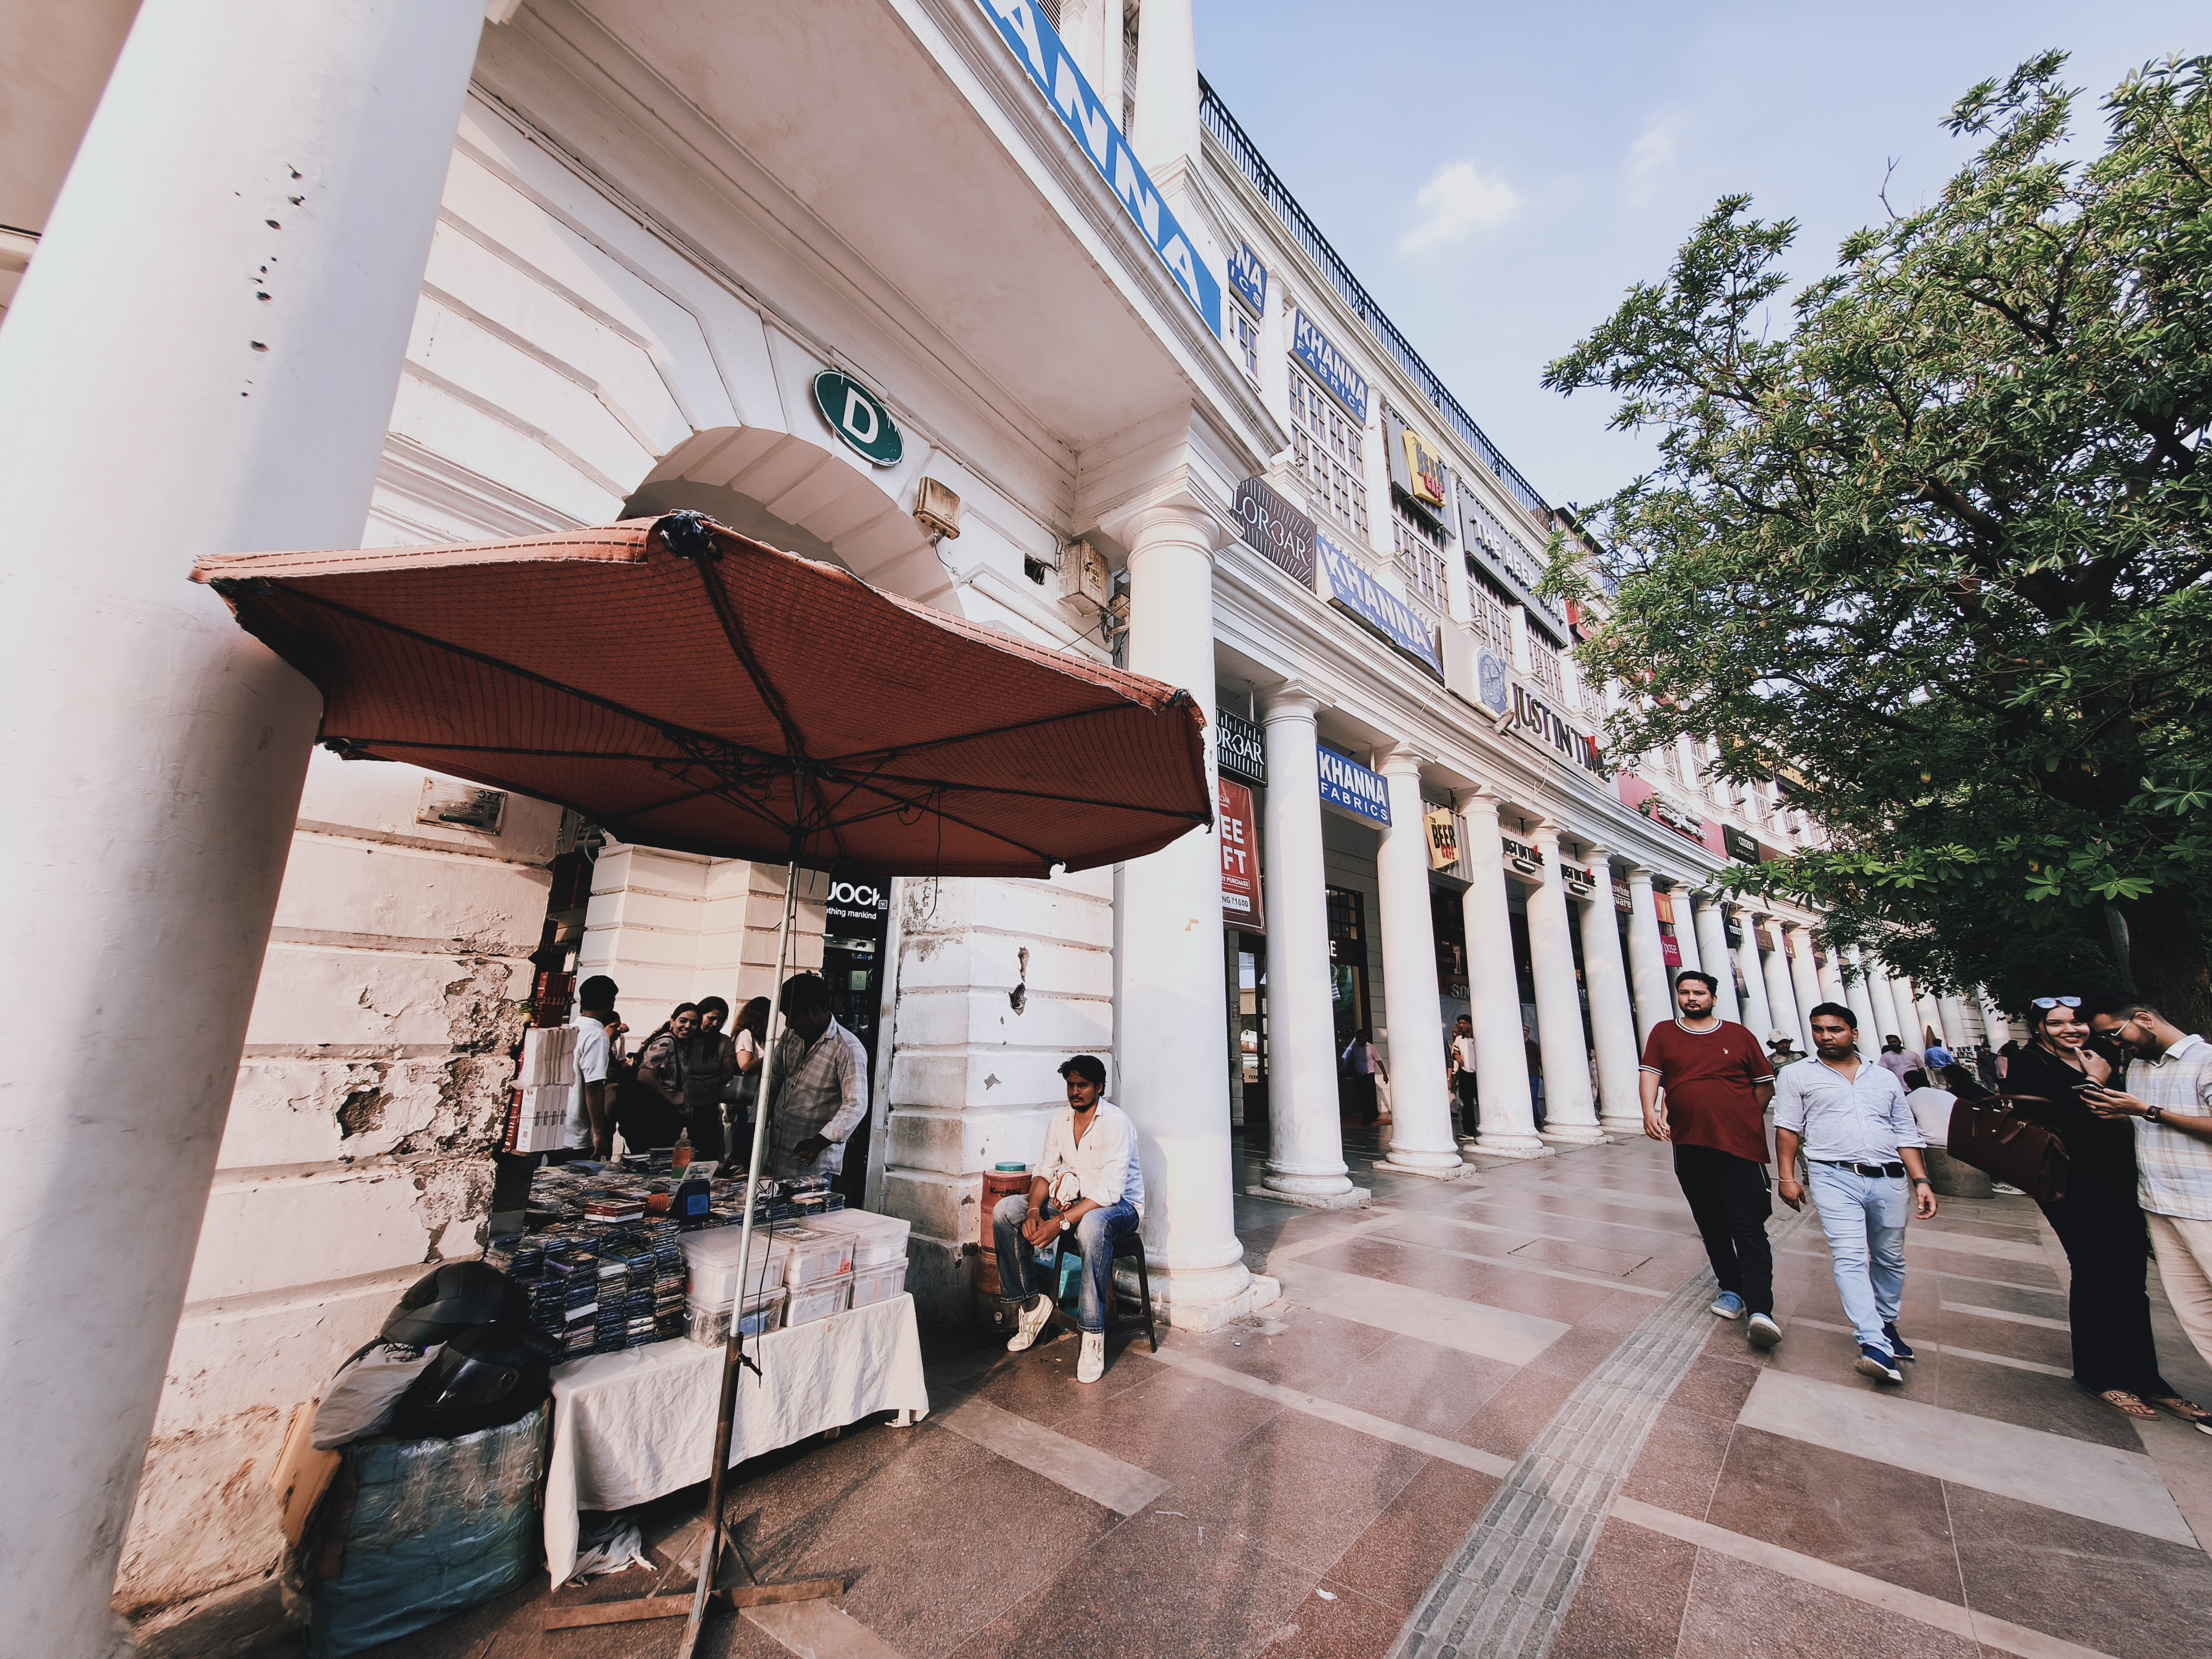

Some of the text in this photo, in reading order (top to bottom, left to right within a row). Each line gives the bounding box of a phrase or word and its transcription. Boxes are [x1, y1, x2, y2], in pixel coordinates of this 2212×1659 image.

[1230, 242, 1263, 297] NA
[1296, 338, 1366, 420] FABRICS
[1297, 313, 1367, 404] KHANNA
[842, 386, 879, 445] D
[1469, 514, 1502, 560] THE
[1321, 542, 1431, 653] KHANNA
[1319, 750, 1387, 807] KHANNA
[1320, 781, 1388, 821] FABRICS
[1431, 824, 1457, 849] BEER
[1226, 876, 1249, 887] PURCHASE
[847, 910, 877, 920] mankind
[1452, 984, 1470, 999] Sn
